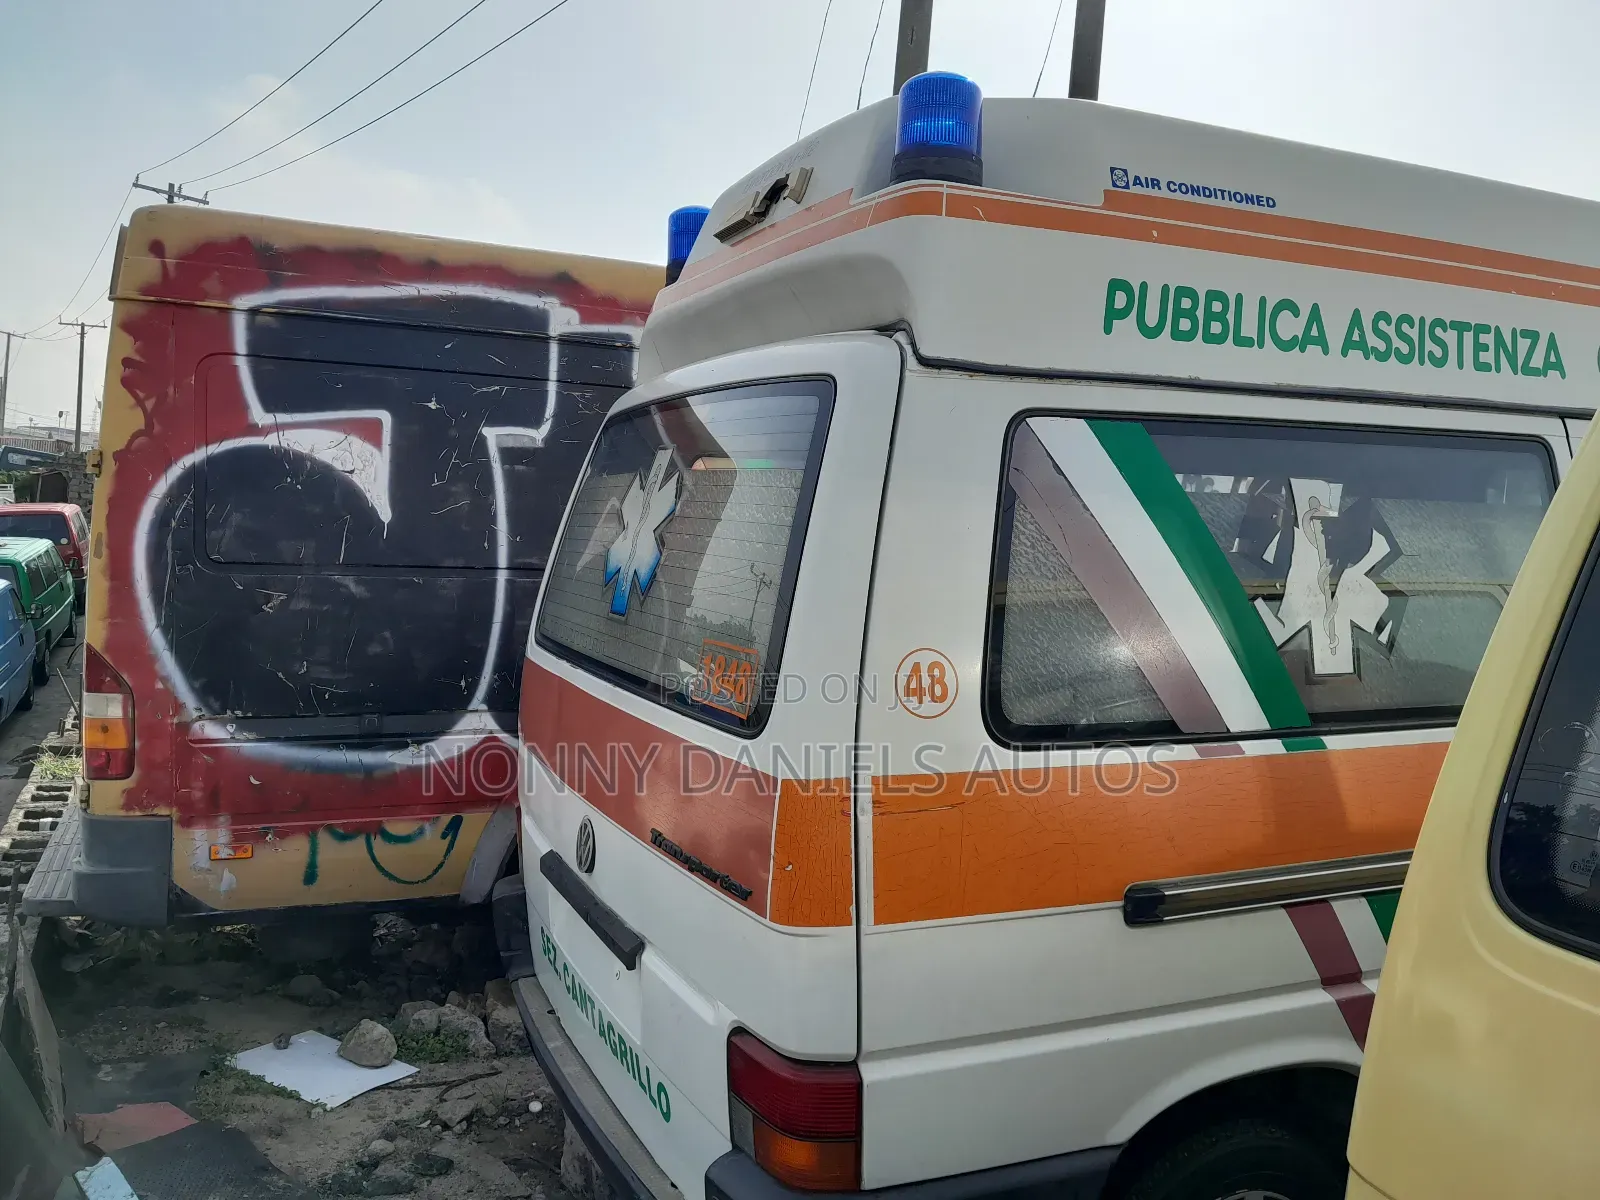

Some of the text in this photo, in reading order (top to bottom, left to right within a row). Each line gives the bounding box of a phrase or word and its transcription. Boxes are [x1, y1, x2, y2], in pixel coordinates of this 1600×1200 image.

[1132, 175, 1277, 209] AIR CONDITIONED
[1103, 277, 1567, 380] PUBBLICA ASSISTENZA
[904, 661, 948, 704] 48
[650, 828, 752, 901] Transporter
